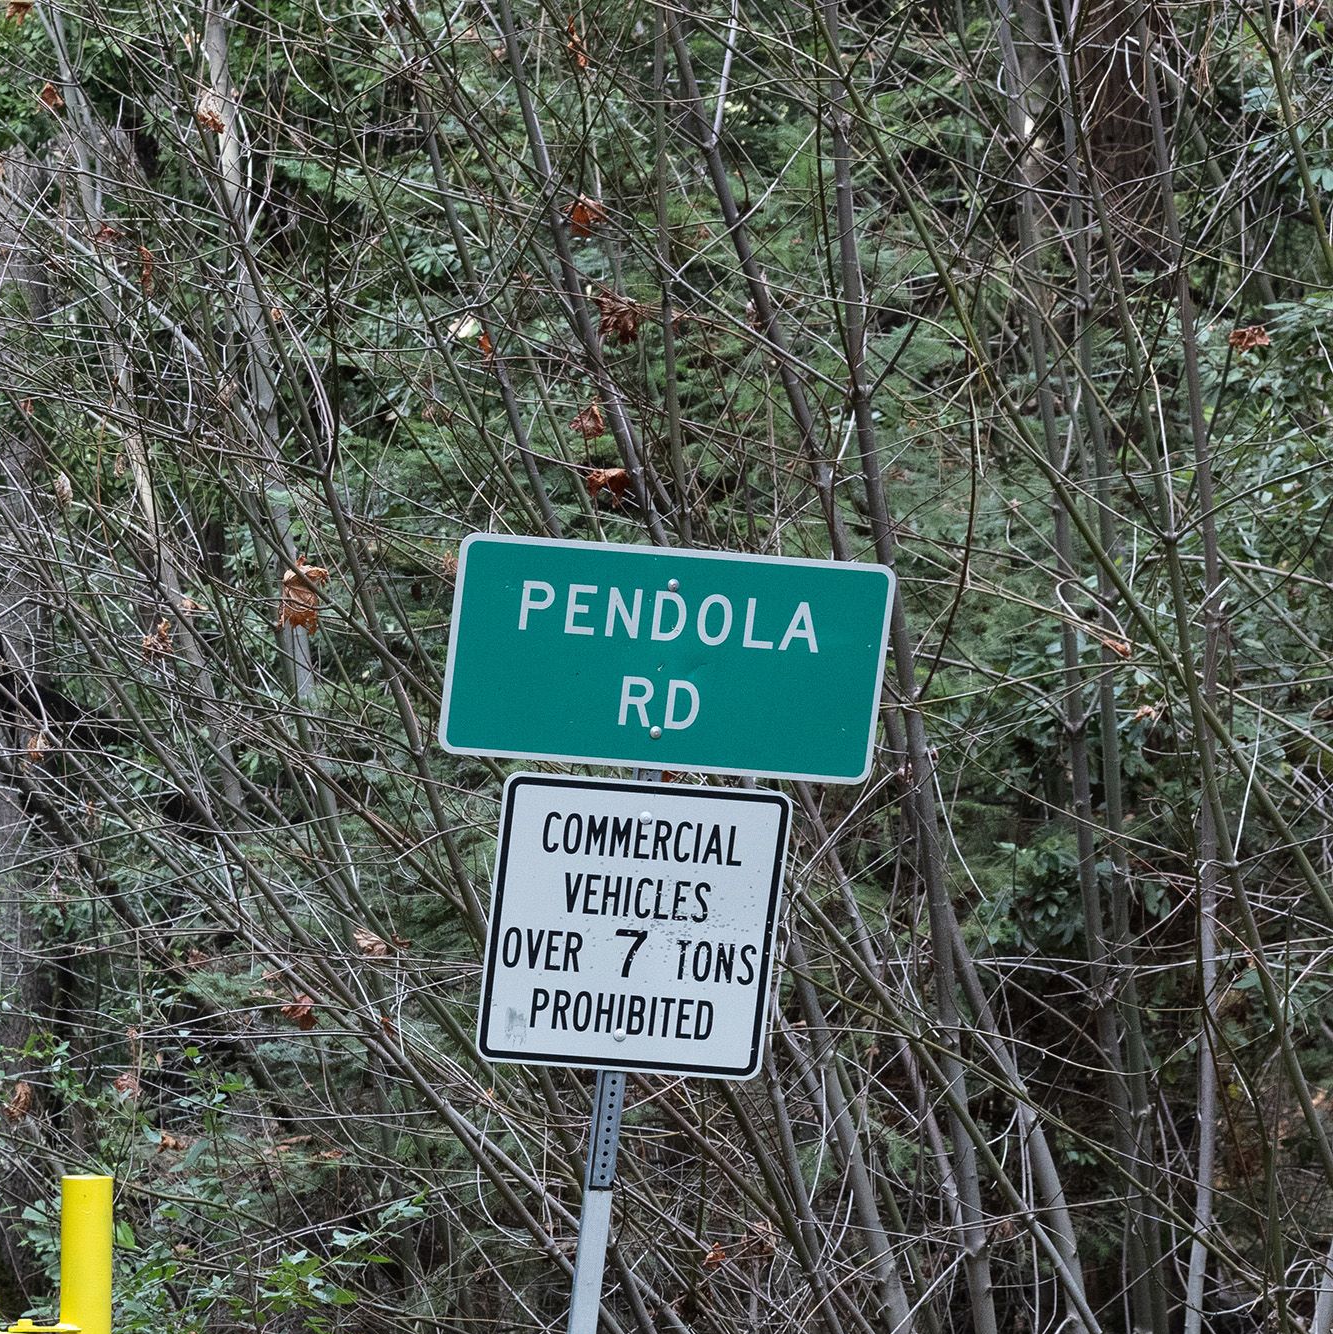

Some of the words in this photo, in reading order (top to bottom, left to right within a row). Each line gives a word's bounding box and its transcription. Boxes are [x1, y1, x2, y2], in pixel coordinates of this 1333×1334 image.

[518, 580, 819, 653] PENDOLA
[617, 675, 700, 730] RD
[542, 811, 742, 867] COMMERCIAL
[564, 872, 712, 923] VEHICLES
[502, 926, 584, 973] OVER
[615, 928, 649, 978] 7
[676, 939, 757, 986] TONS
[529, 987, 714, 1041] PROHIBITED
